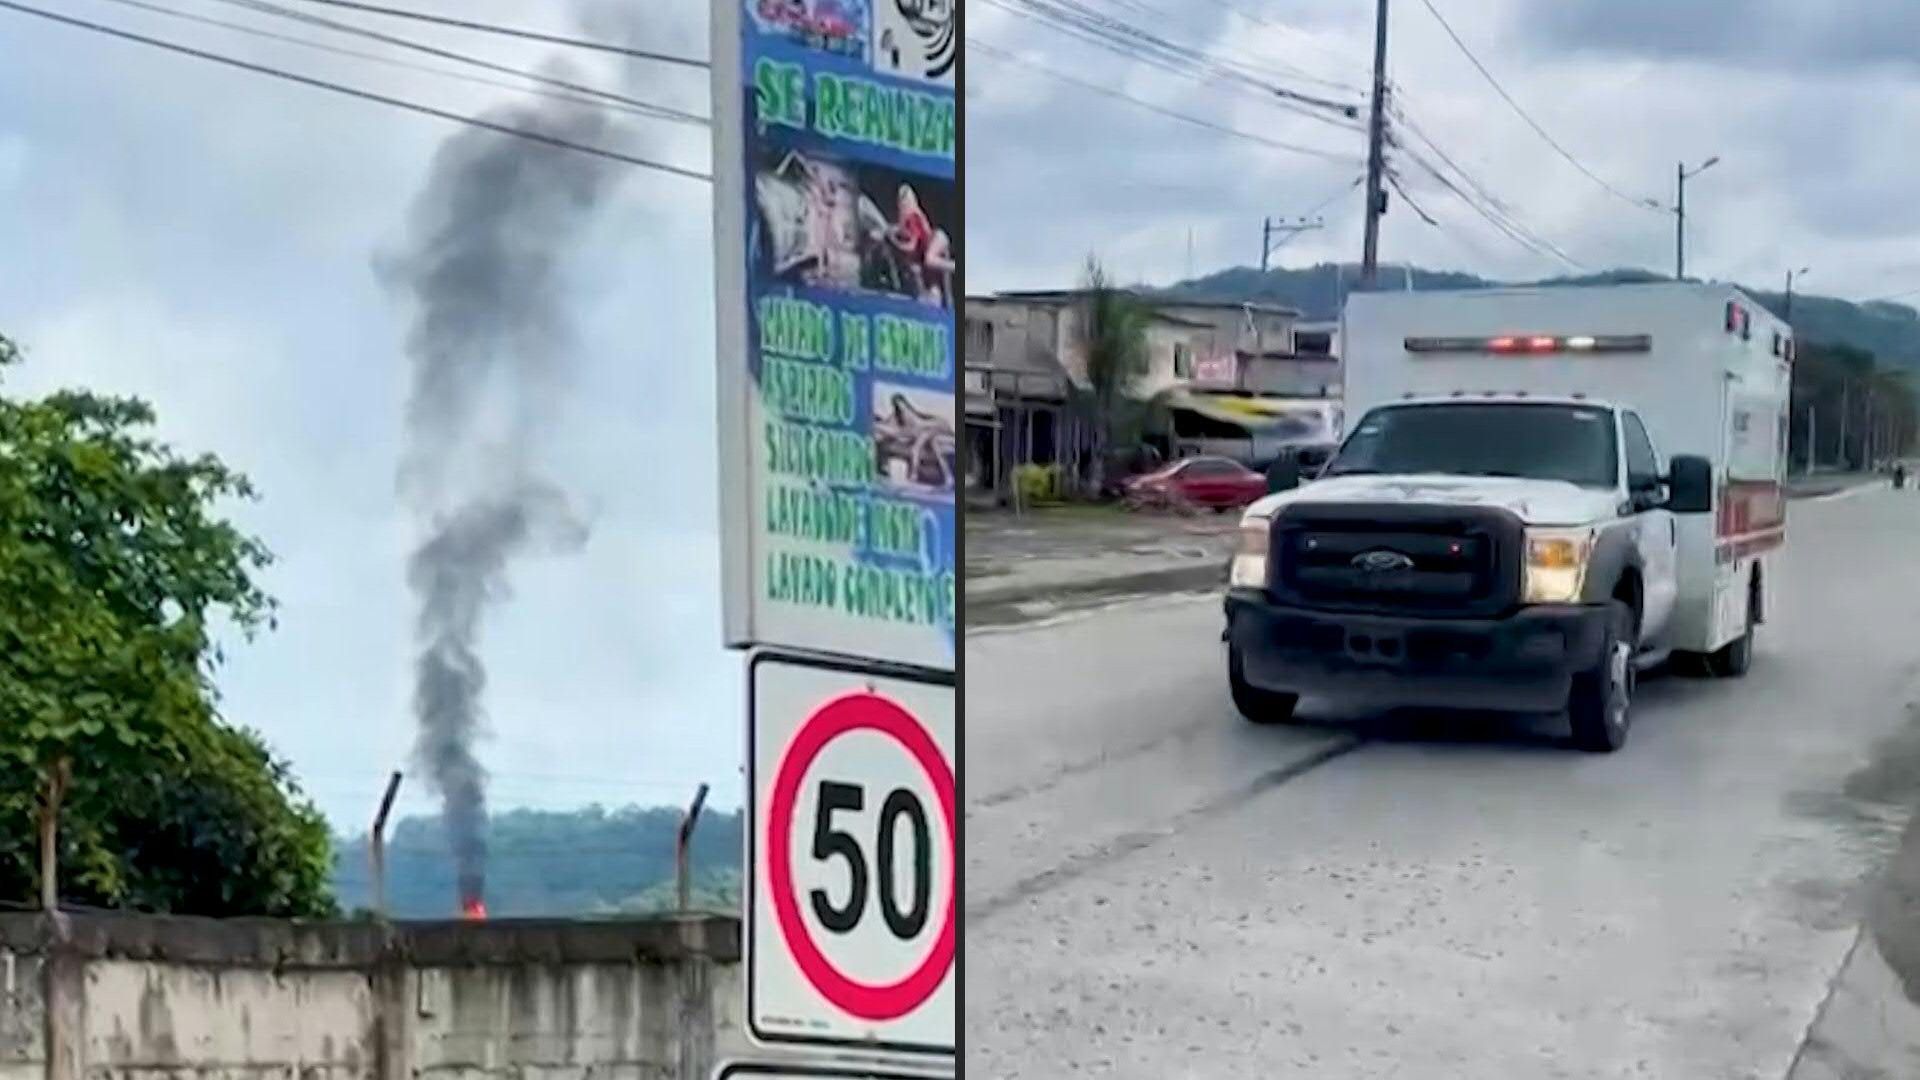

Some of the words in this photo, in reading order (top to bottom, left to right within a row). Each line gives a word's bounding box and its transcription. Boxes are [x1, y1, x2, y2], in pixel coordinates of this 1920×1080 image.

[756, 57, 806, 127] SE
[842, 311, 870, 371] DE
[766, 551, 837, 607] LAVADO
[843, 562, 937, 625] COMPLETO
[810, 780, 931, 940] 50
